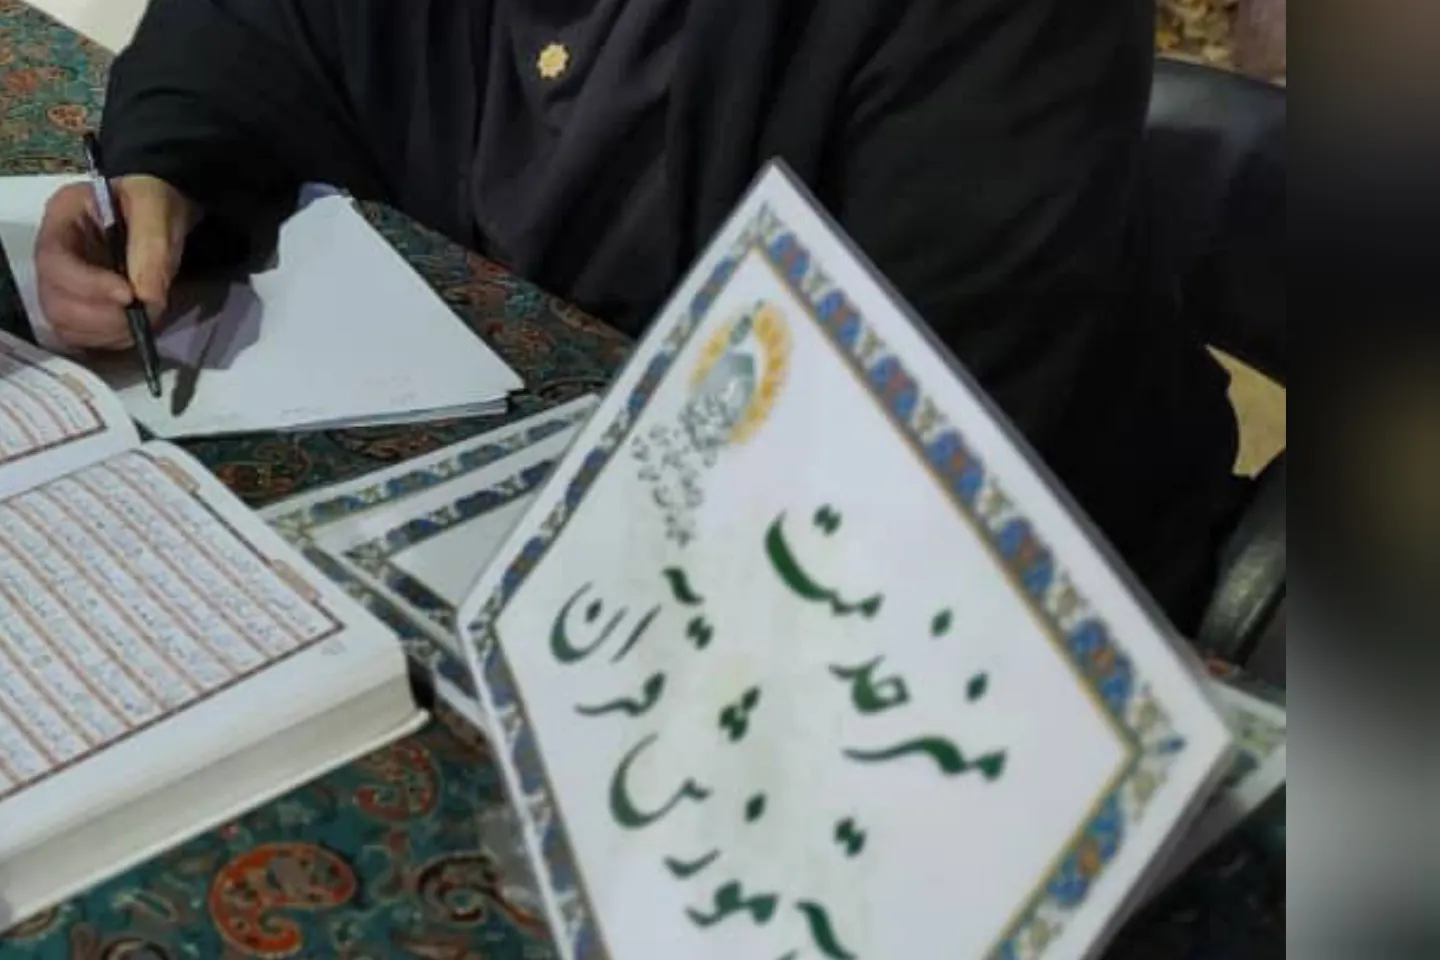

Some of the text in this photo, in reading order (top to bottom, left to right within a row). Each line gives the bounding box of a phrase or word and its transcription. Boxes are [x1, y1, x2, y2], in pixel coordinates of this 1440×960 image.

[549, 565, 714, 719] قرآن
[763, 504, 1009, 858] میز خدمت
[608, 685, 858, 960] موزش
